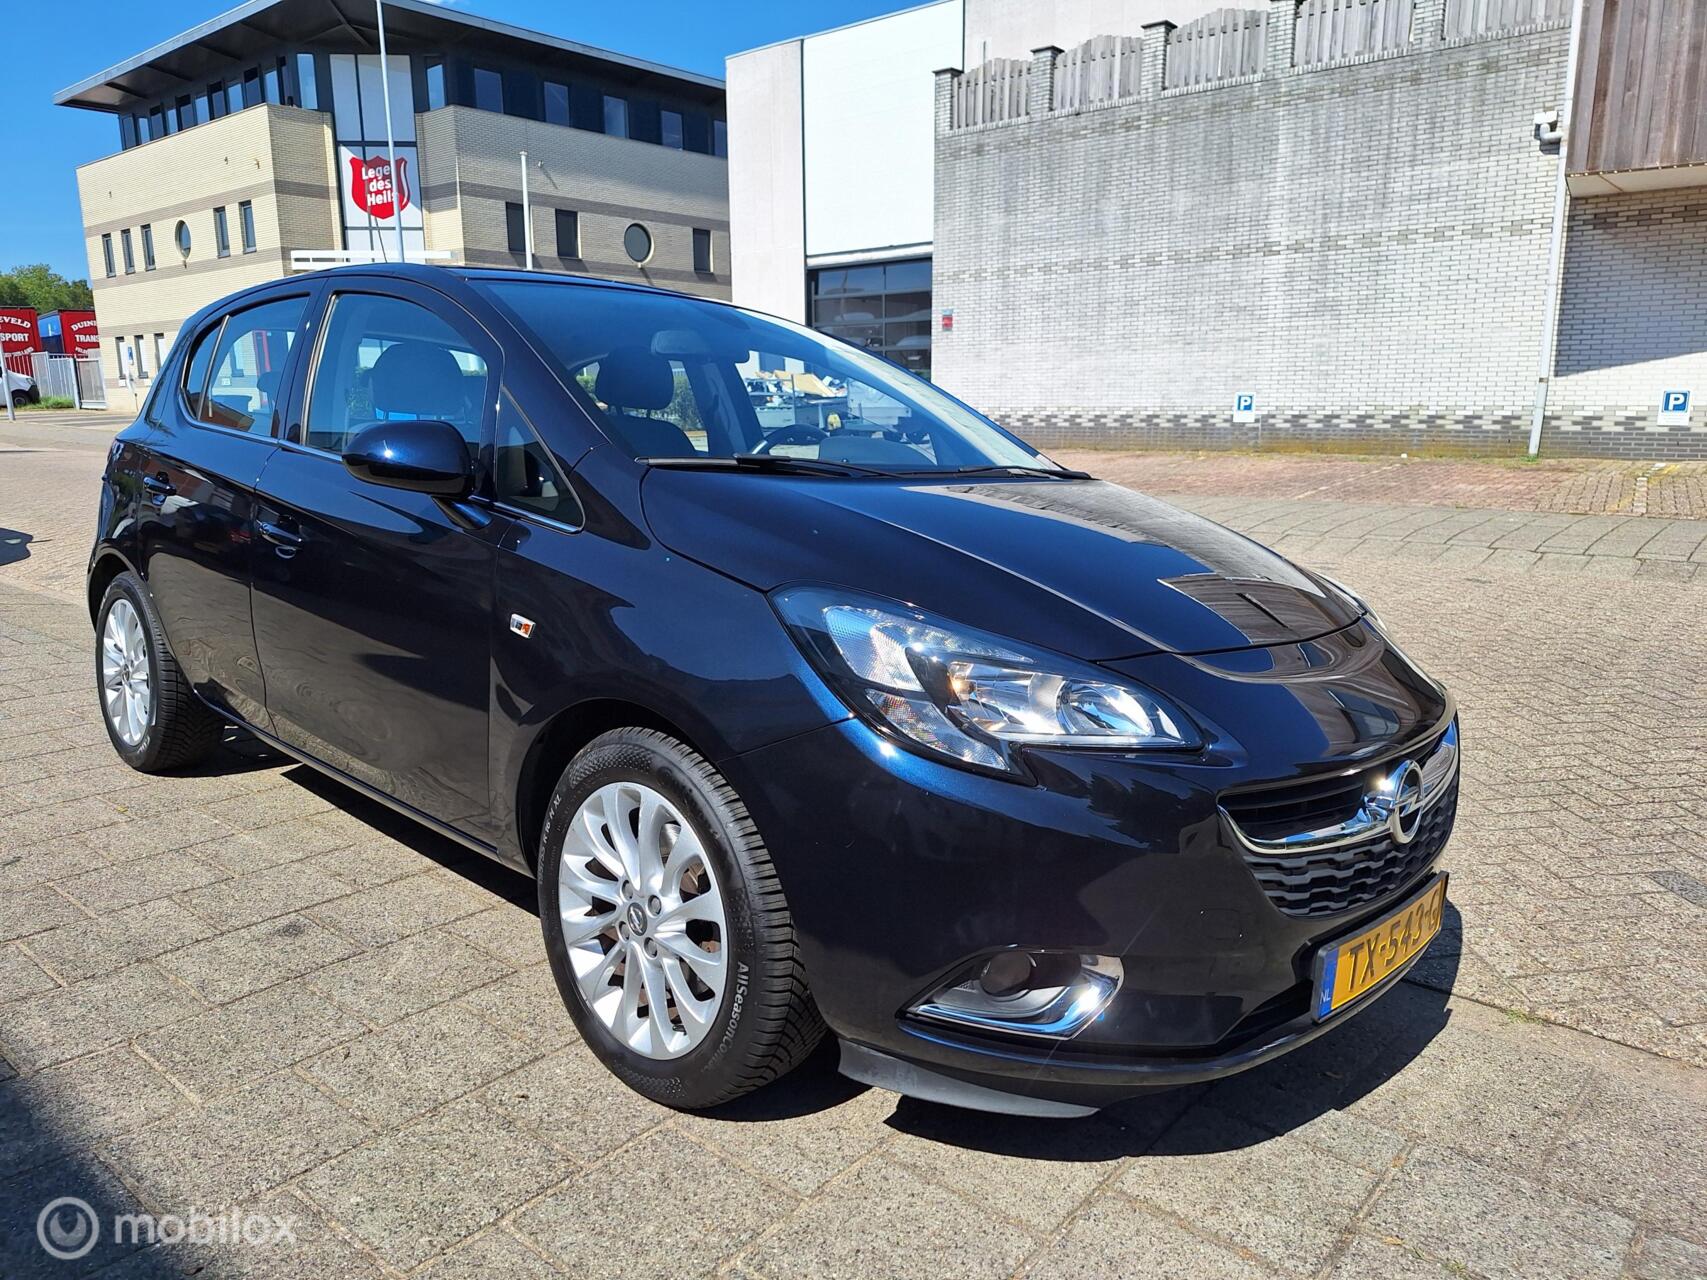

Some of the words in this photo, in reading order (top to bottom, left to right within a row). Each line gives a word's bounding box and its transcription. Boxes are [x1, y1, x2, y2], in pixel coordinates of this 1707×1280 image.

[362, 165, 394, 180] Lege
[369, 179, 391, 192] des
[1240, 396, 1251, 410] P
[1668, 393, 1685, 410] P
[1319, 989, 1331, 1004] NL
[701, 961, 749, 1073] AllSeasonCon
